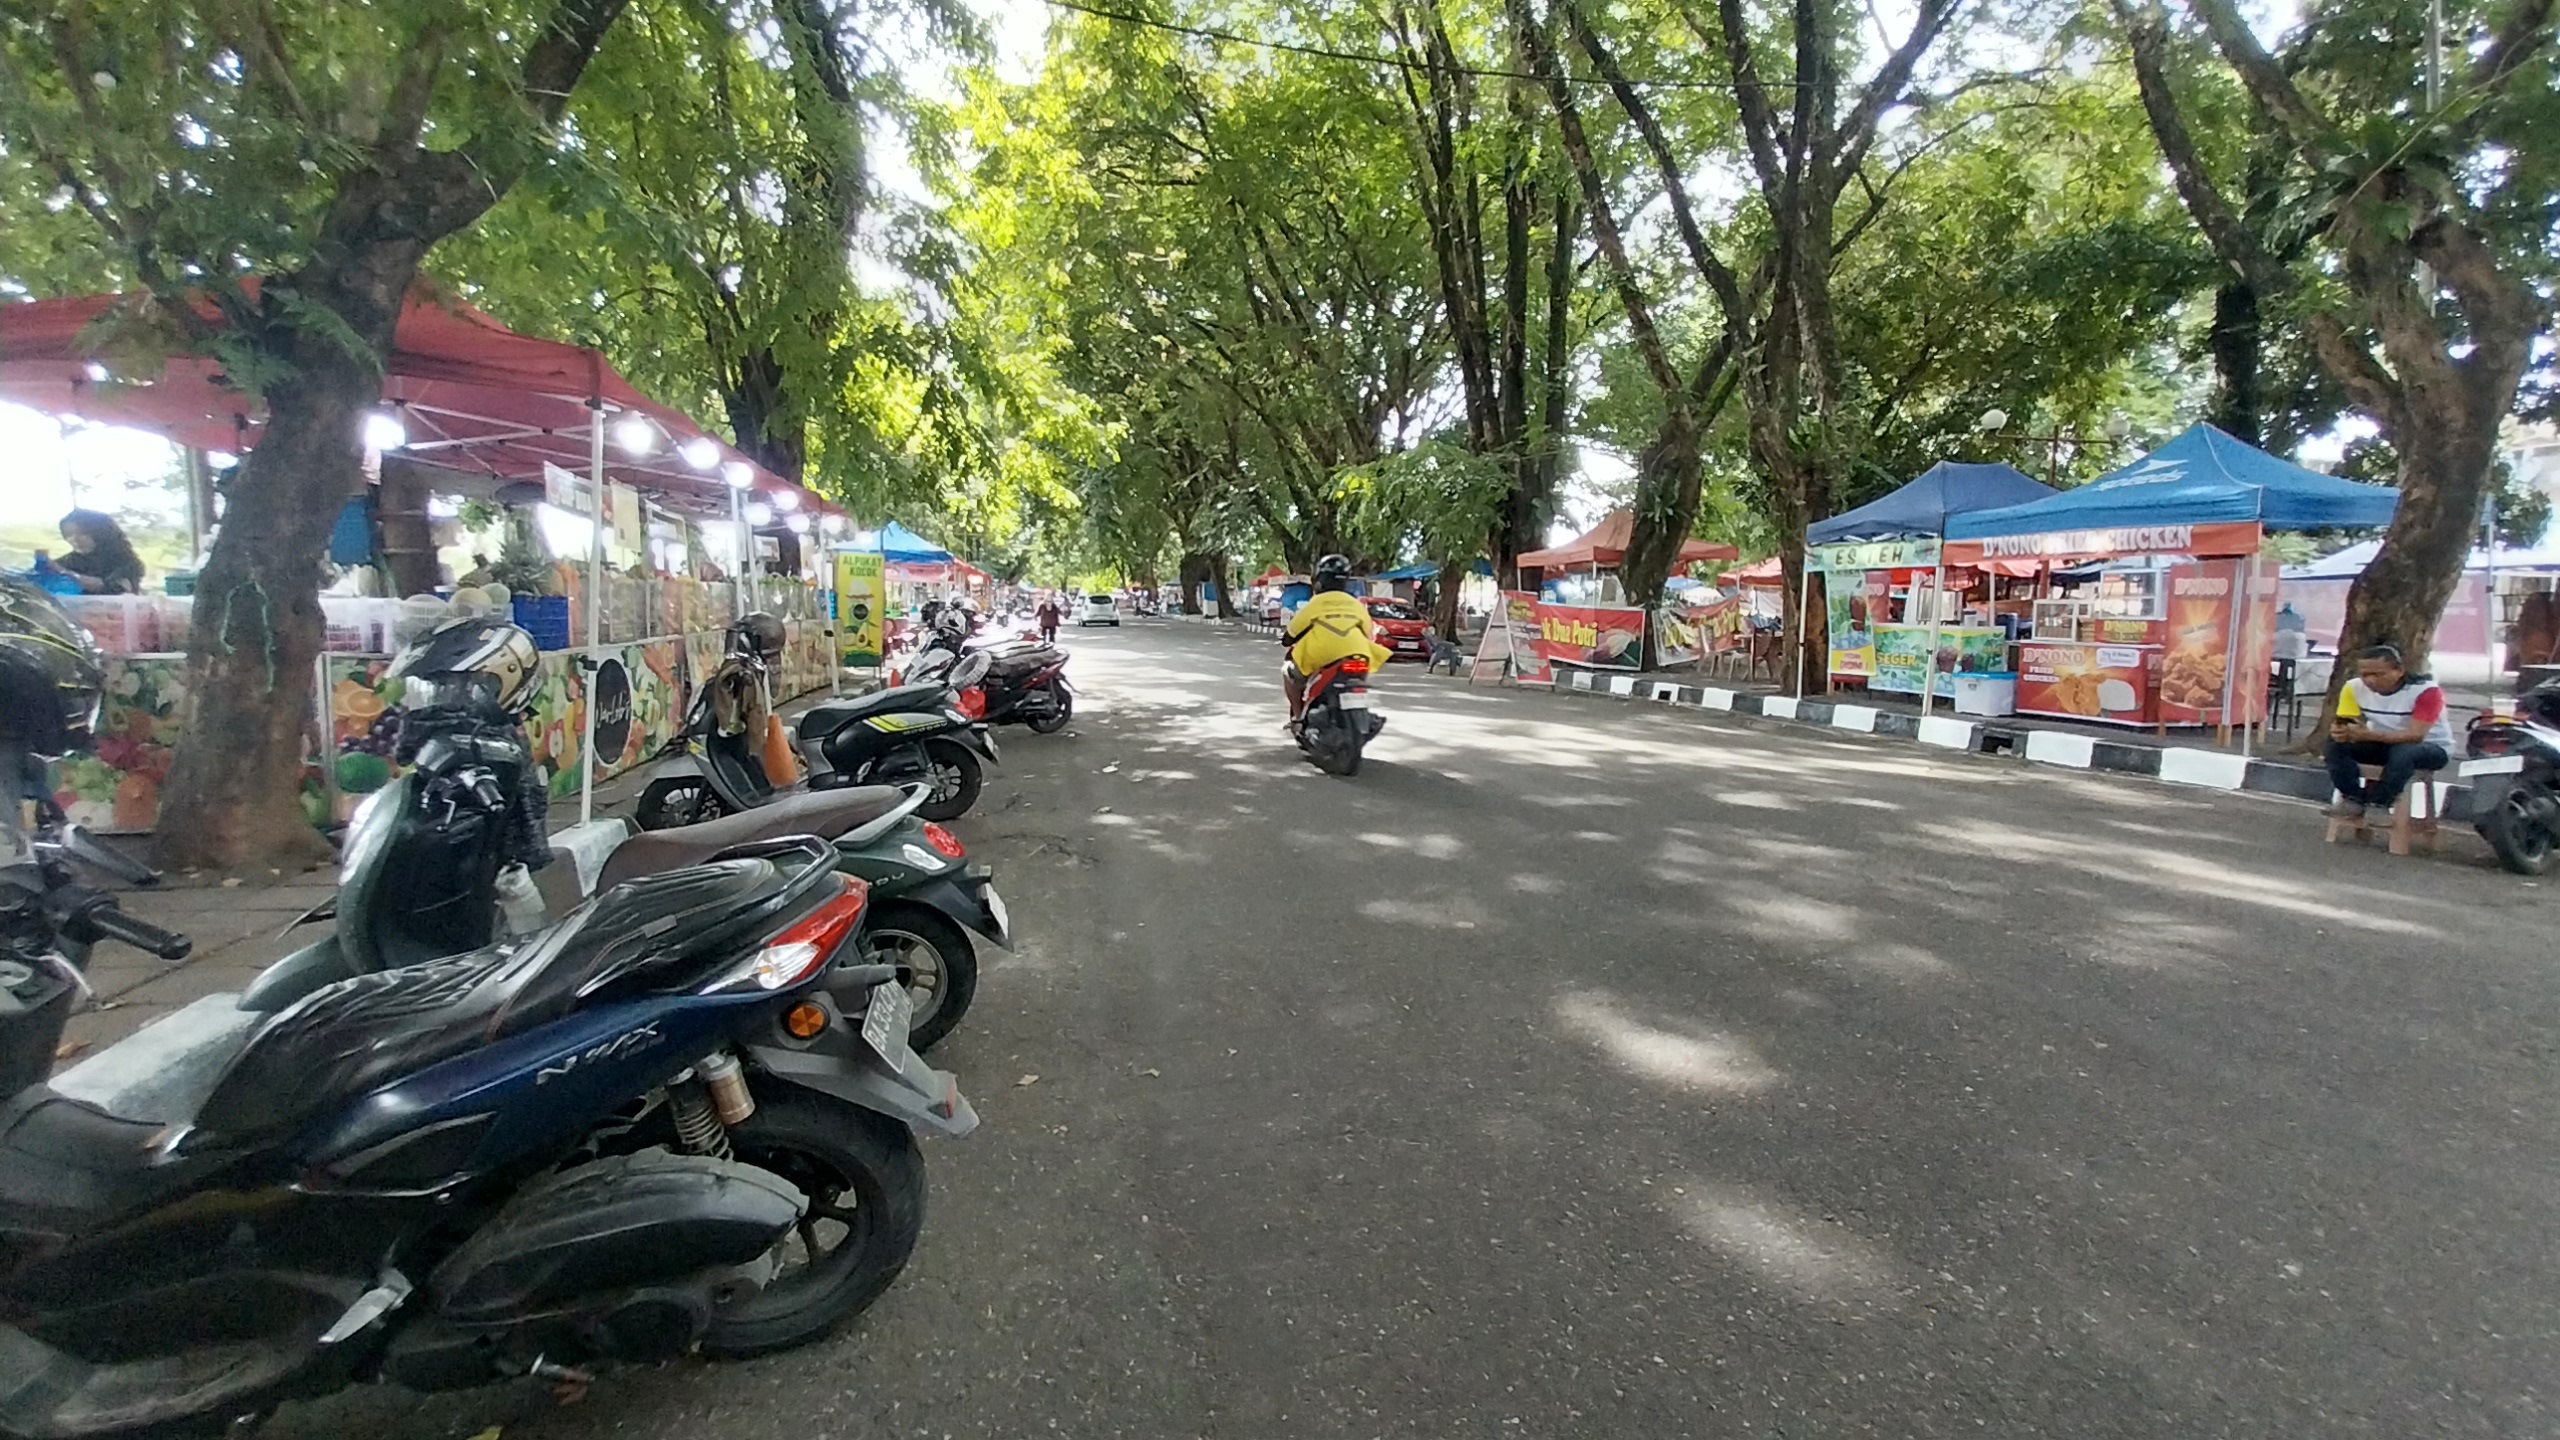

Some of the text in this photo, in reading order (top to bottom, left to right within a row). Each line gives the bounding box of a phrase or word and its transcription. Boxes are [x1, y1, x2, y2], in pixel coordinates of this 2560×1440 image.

[2104, 525, 2194, 551] CHICKEN
[842, 555, 883, 568] ALPUKAT
[1835, 548, 1858, 565] ES
[849, 567, 878, 578] KOCOK
[1572, 619, 1599, 649] Putri
[1876, 651, 1918, 667] SEGER
[2022, 648, 2085, 665] D'NONO
